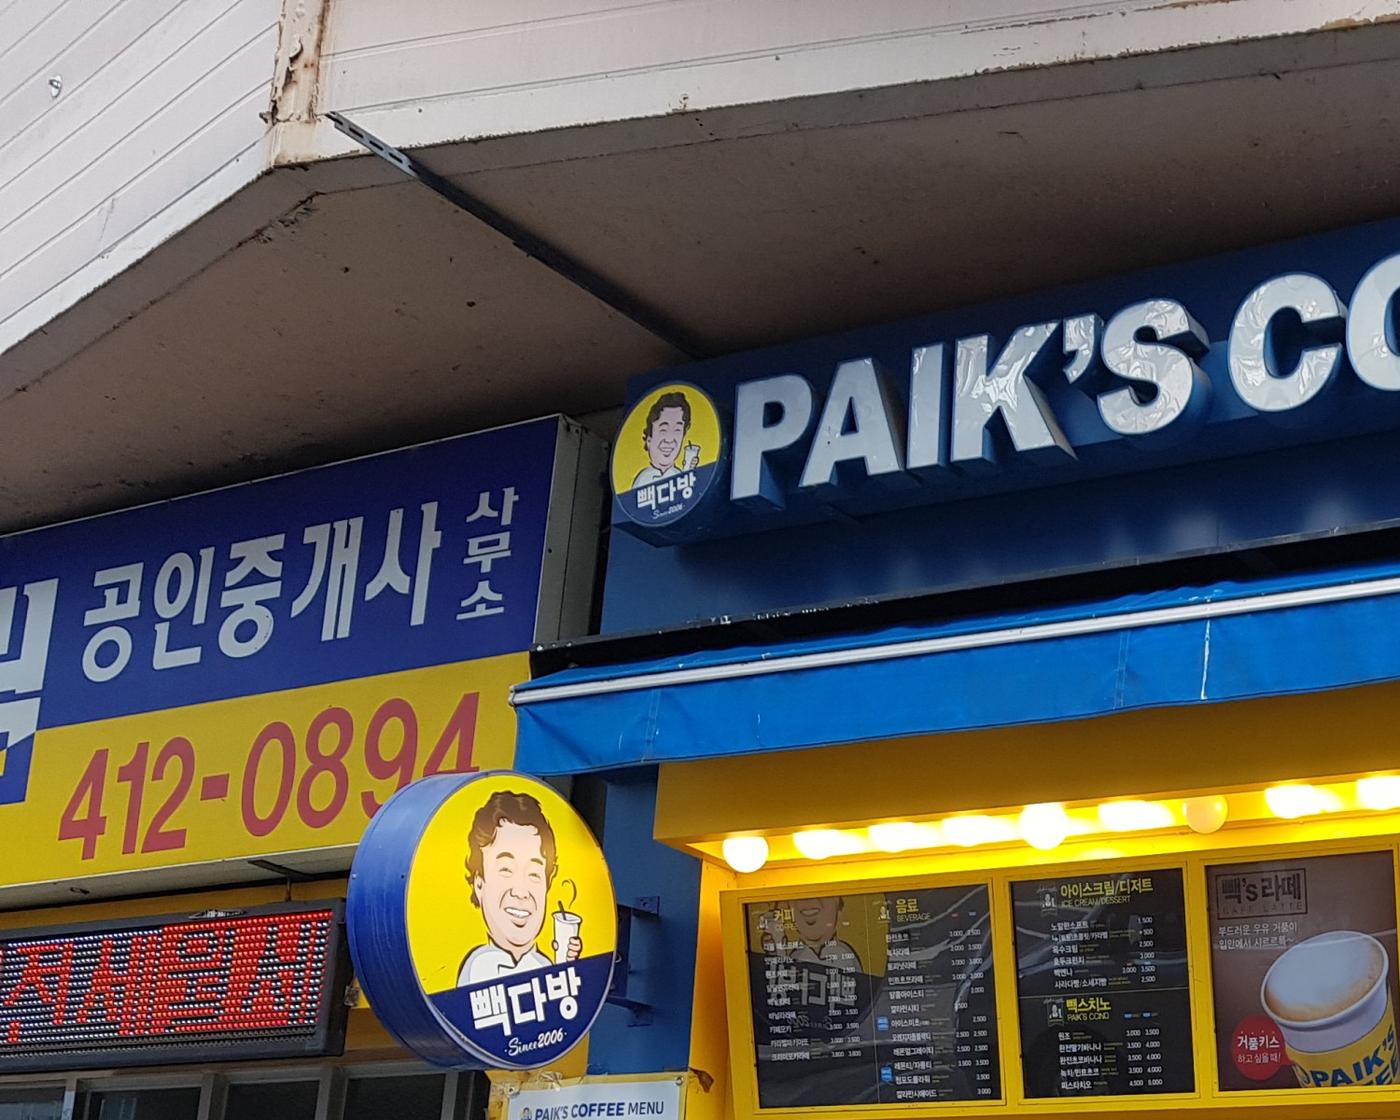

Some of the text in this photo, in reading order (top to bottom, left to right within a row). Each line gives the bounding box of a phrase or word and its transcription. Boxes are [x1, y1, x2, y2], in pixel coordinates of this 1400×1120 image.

[730, 298, 1203, 502] PAIK'S
[636, 471, 697, 511] 빽다방
[455, 487, 519, 622] 사무소
[82, 500, 441, 683] 공인중개사
[58, 692, 480, 861] 412-0894
[1060, 878, 1154, 899] 아이스크림/디저트
[896, 898, 919, 914] 음료
[896, 912, 931, 922] BEVERAGE
[1218, 924, 1251, 936] 부드러운
[1253, 922, 1270, 934] 우유
[469, 968, 581, 1035] 빽다방
[1066, 996, 1112, 1013] 빽스치노
[536, 1029, 564, 1050] 2006
[1237, 1034, 1281, 1051] 거품키스
[571, 1102, 625, 1118] COFFEE
[627, 1101, 664, 1116] MENU
